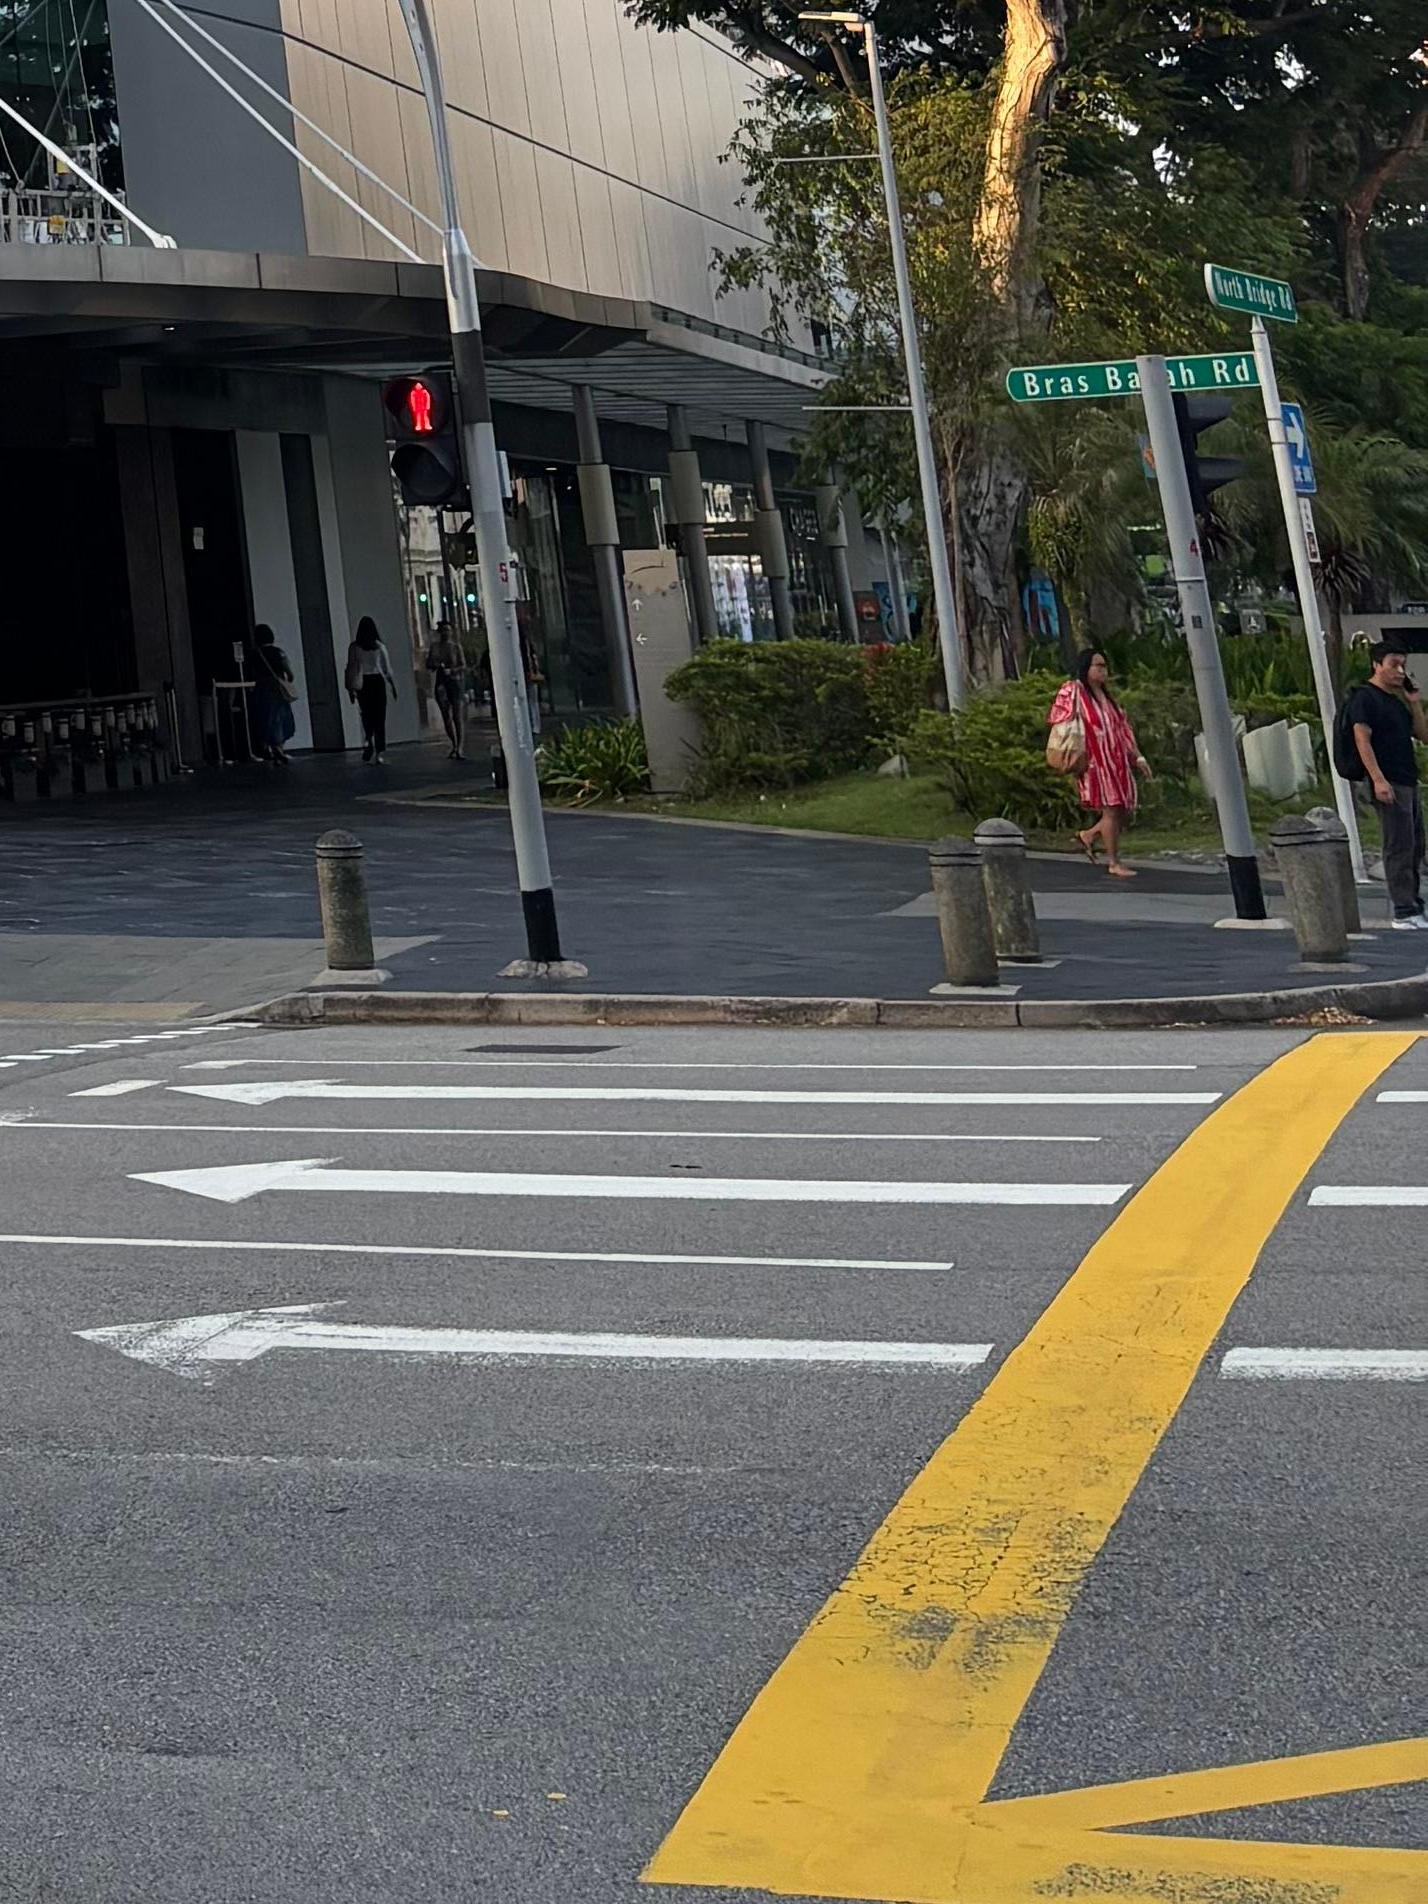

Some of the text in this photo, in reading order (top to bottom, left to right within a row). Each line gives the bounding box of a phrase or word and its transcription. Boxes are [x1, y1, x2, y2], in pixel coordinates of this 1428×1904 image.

[1278, 286, 1293, 311] Rd
[1023, 357, 1251, 397] Bras Baah Rd
